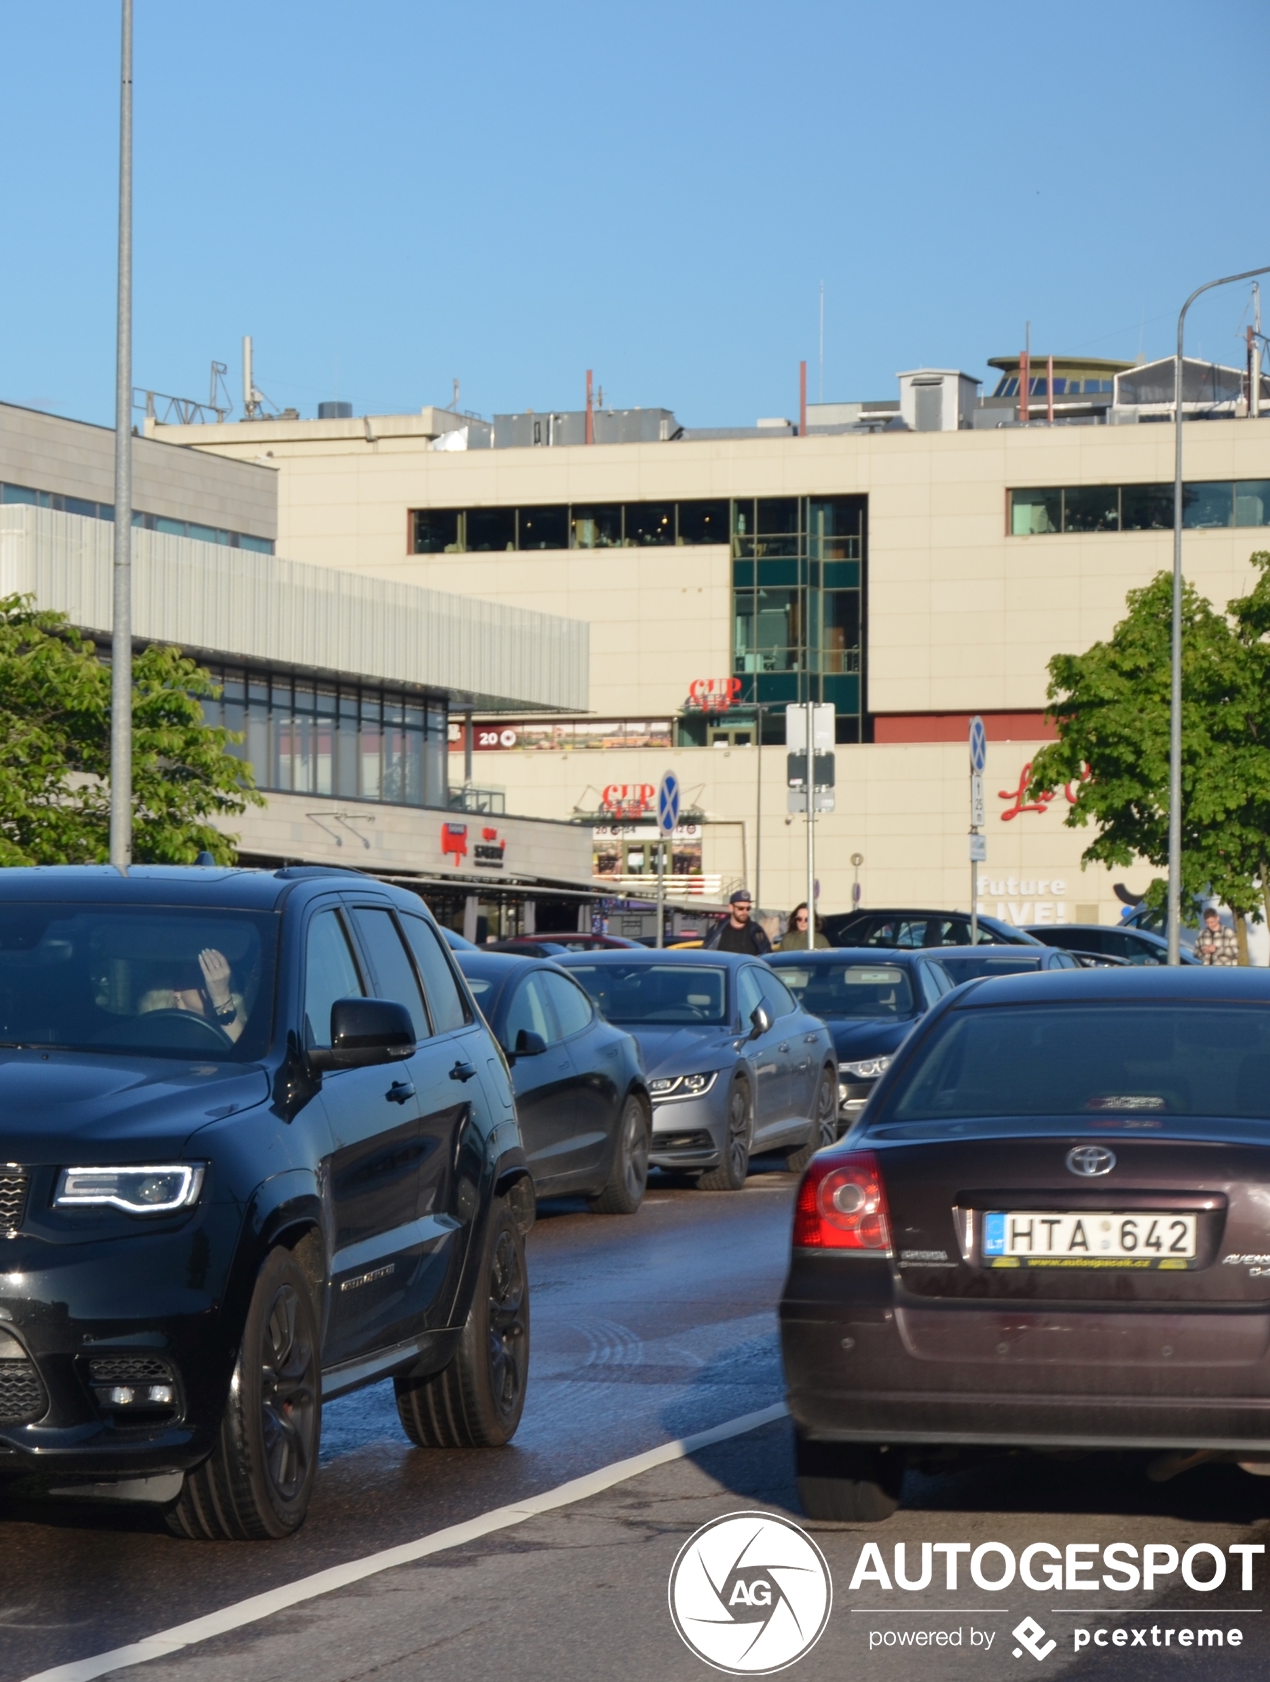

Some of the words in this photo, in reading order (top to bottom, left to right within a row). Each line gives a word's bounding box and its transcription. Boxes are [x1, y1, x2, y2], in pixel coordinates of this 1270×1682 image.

[689, 678, 742, 704] CUP
[479, 732, 498, 746] 20
[602, 784, 656, 808] CUP
[976, 876, 1066, 896] future
[1009, 1218, 1092, 1253] HTA
[1119, 1219, 1189, 1253] 642
